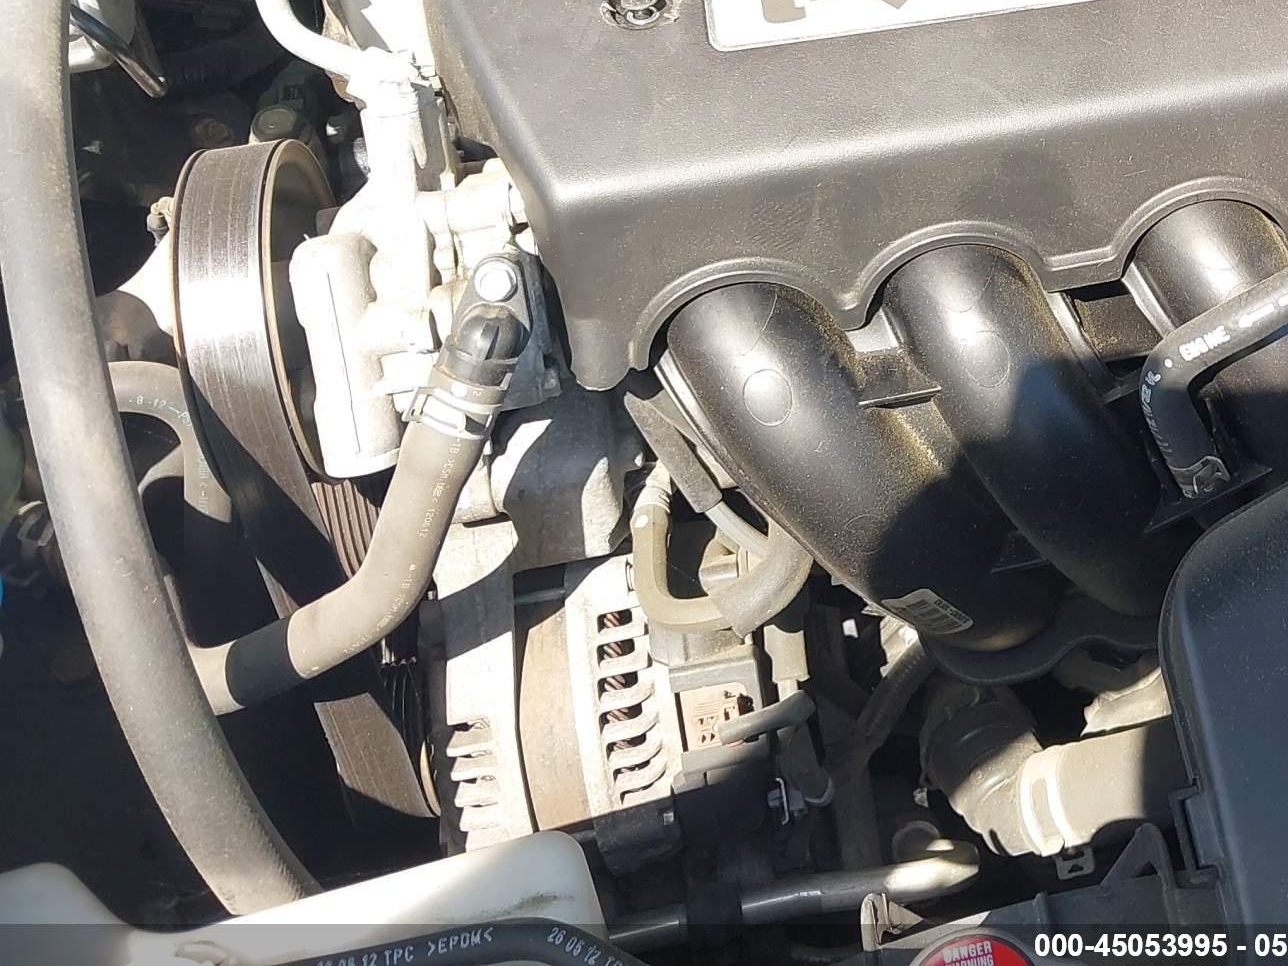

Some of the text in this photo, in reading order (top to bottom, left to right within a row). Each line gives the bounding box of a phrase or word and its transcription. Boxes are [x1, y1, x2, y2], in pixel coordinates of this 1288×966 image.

[1177, 324, 1231, 362] ENGINE
[547, 926, 567, 945] 26
[383, 945, 415, 966] TPC
[942, 940, 993, 964] DANGER
